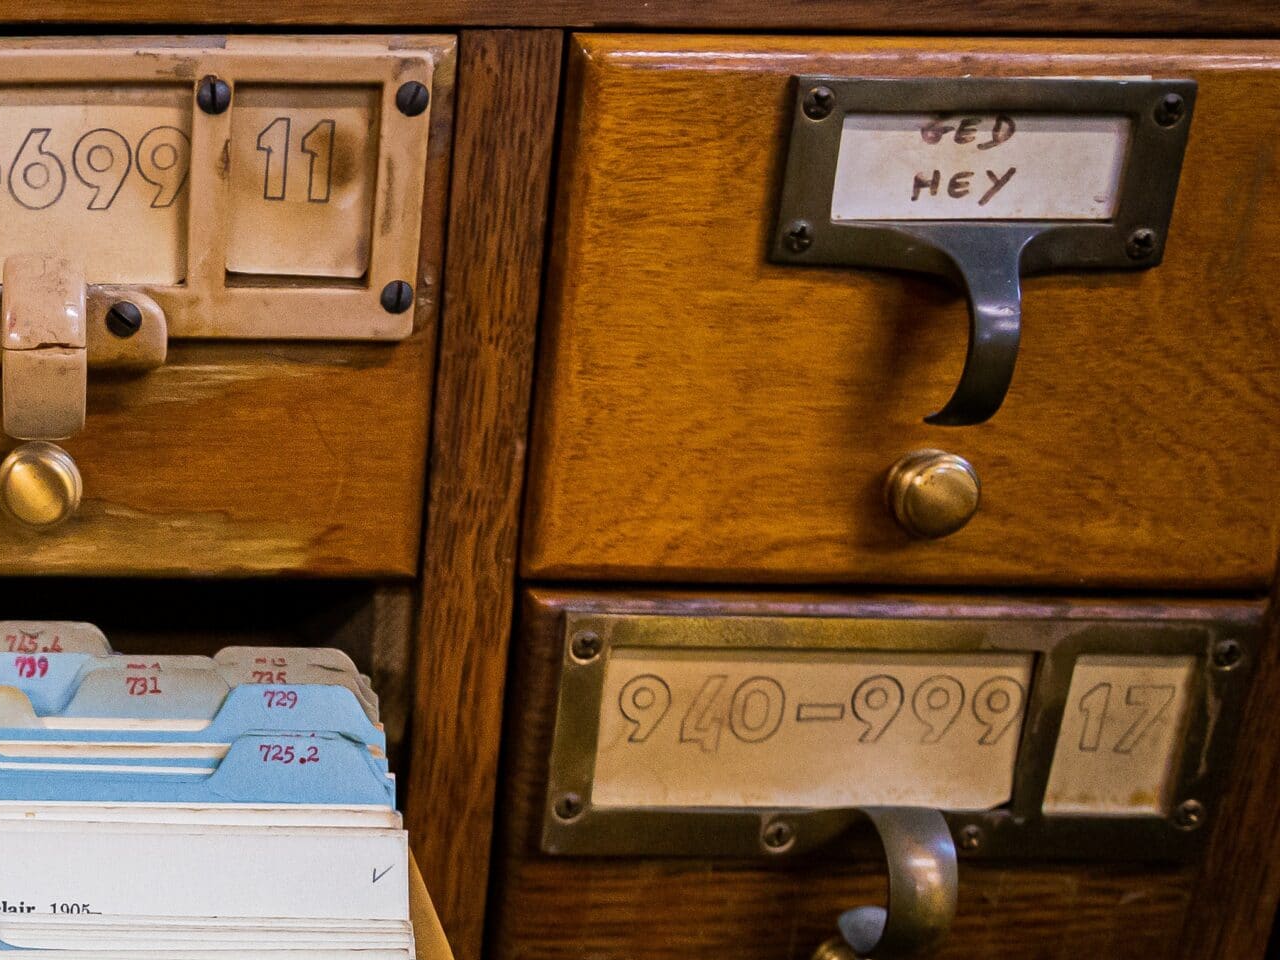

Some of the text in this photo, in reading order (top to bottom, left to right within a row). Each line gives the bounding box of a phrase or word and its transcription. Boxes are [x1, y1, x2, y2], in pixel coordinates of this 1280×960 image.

[256, 117, 335, 204] 11
[910, 167, 1018, 206] HEY
[126, 677, 162, 694] 731
[263, 690, 298, 709] 729
[617, 672, 1026, 752] 940-999
[1077, 682, 1176, 755] 17
[259, 744, 320, 764] 725.2
